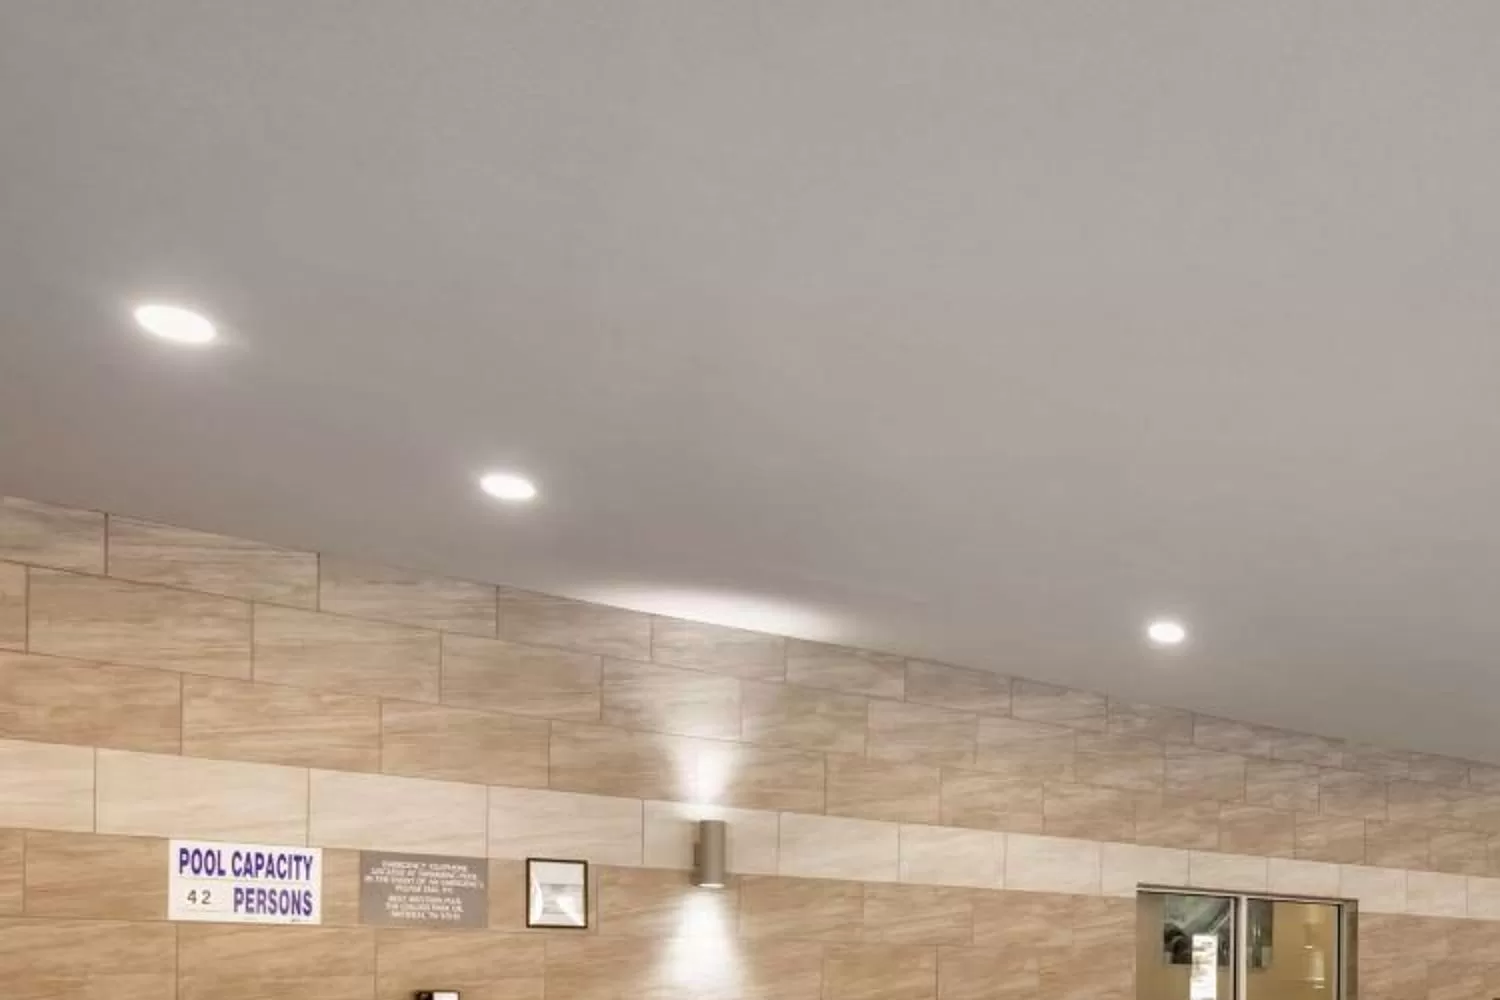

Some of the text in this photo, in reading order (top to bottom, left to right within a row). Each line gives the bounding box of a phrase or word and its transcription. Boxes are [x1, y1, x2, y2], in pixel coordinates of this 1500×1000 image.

[179, 848, 313, 880] POOL CAPACITY
[233, 887, 313, 916] PERSONS
